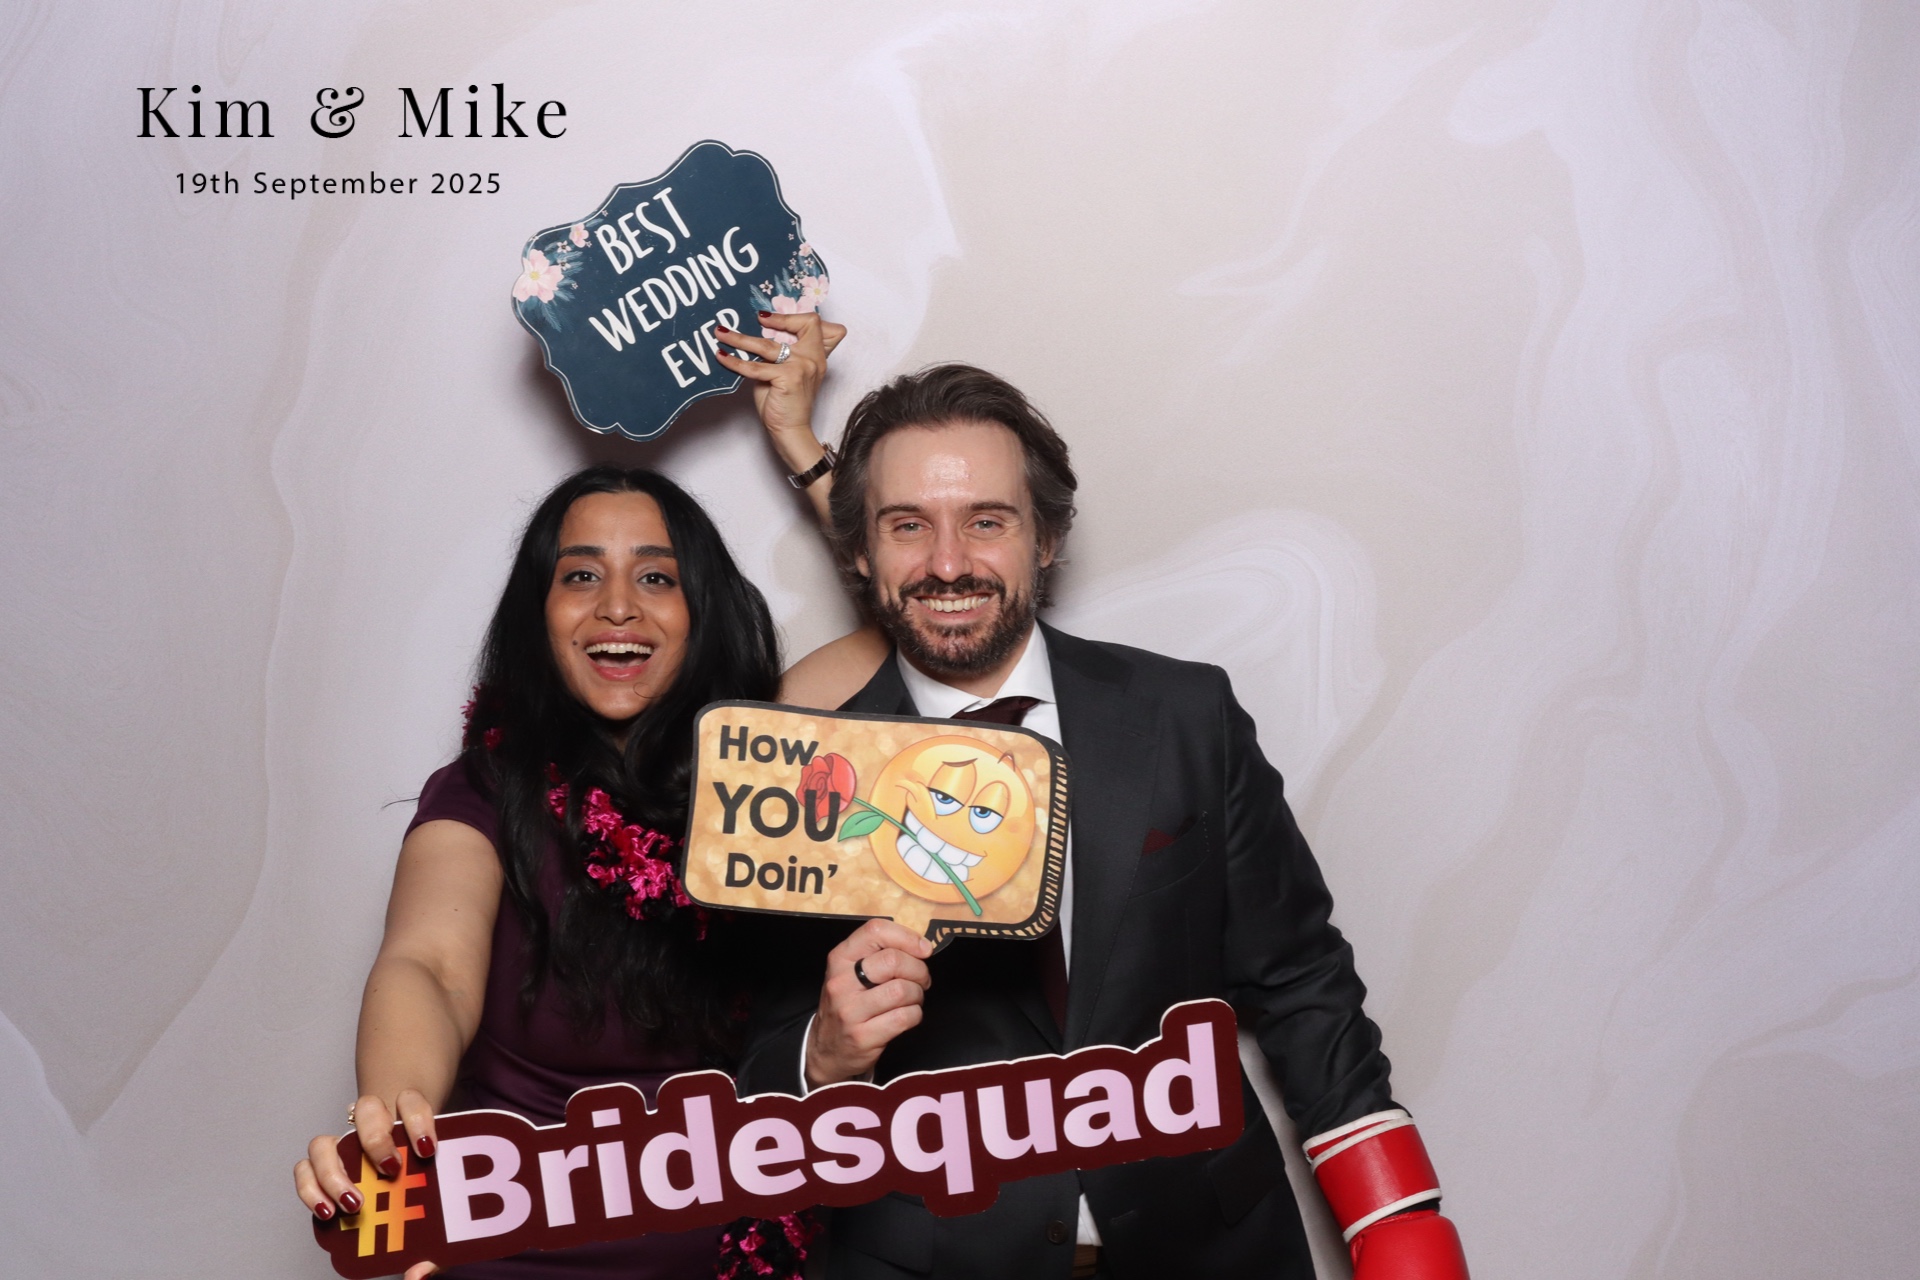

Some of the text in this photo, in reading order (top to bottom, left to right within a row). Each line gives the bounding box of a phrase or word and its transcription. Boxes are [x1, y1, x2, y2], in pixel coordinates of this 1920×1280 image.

[596, 187, 691, 274] BEST
[588, 226, 759, 352] WEDDING
[719, 725, 819, 766] How
[713, 781, 841, 842] YOU
[339, 1021, 1222, 1258] #Bridesquad
